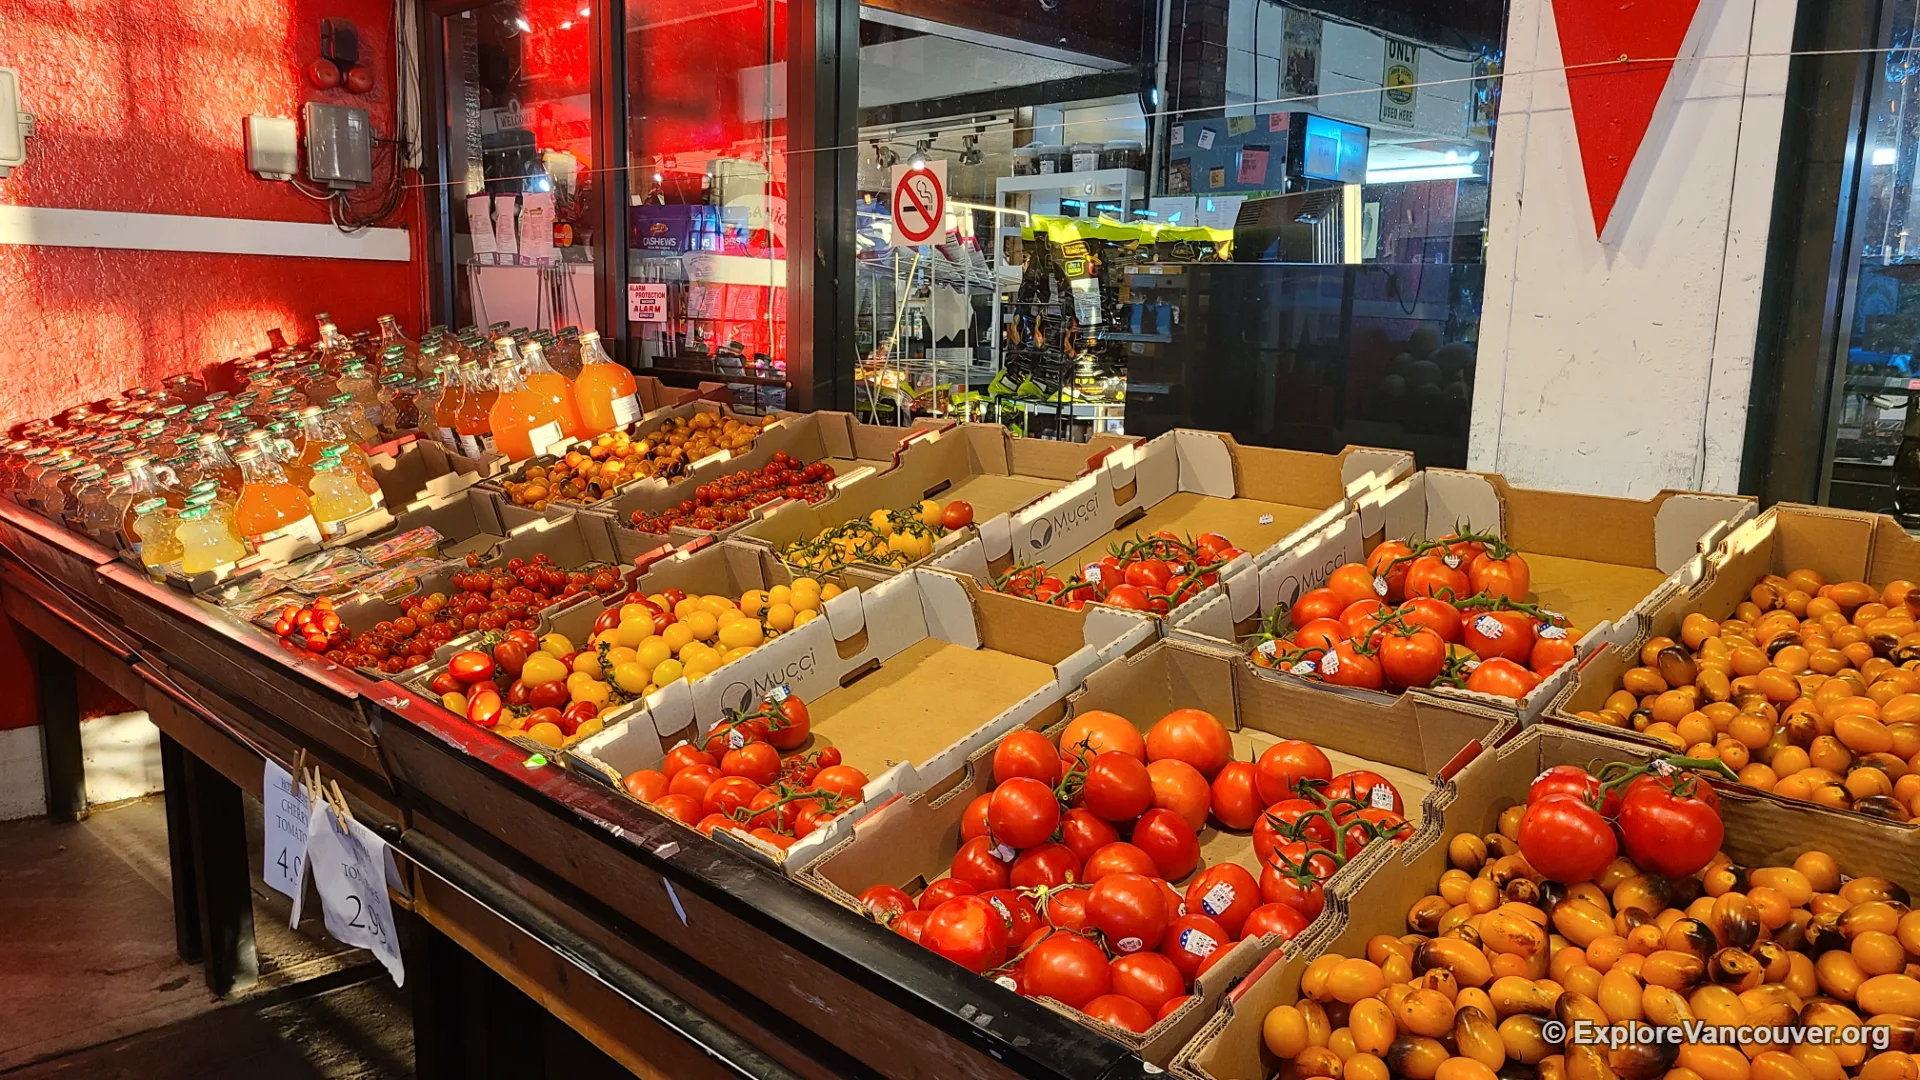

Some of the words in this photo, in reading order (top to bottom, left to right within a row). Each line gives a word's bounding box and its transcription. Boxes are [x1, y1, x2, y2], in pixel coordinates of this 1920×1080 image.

[1388, 41, 1417, 64] ONLY
[499, 112, 532, 128] WELCOME
[1383, 107, 1397, 120] USED
[1398, 109, 1413, 122] HERE
[642, 236, 677, 247] CASHEWS
[633, 305, 661, 313] ALARM
[1057, 511, 1098, 538] FARMS
